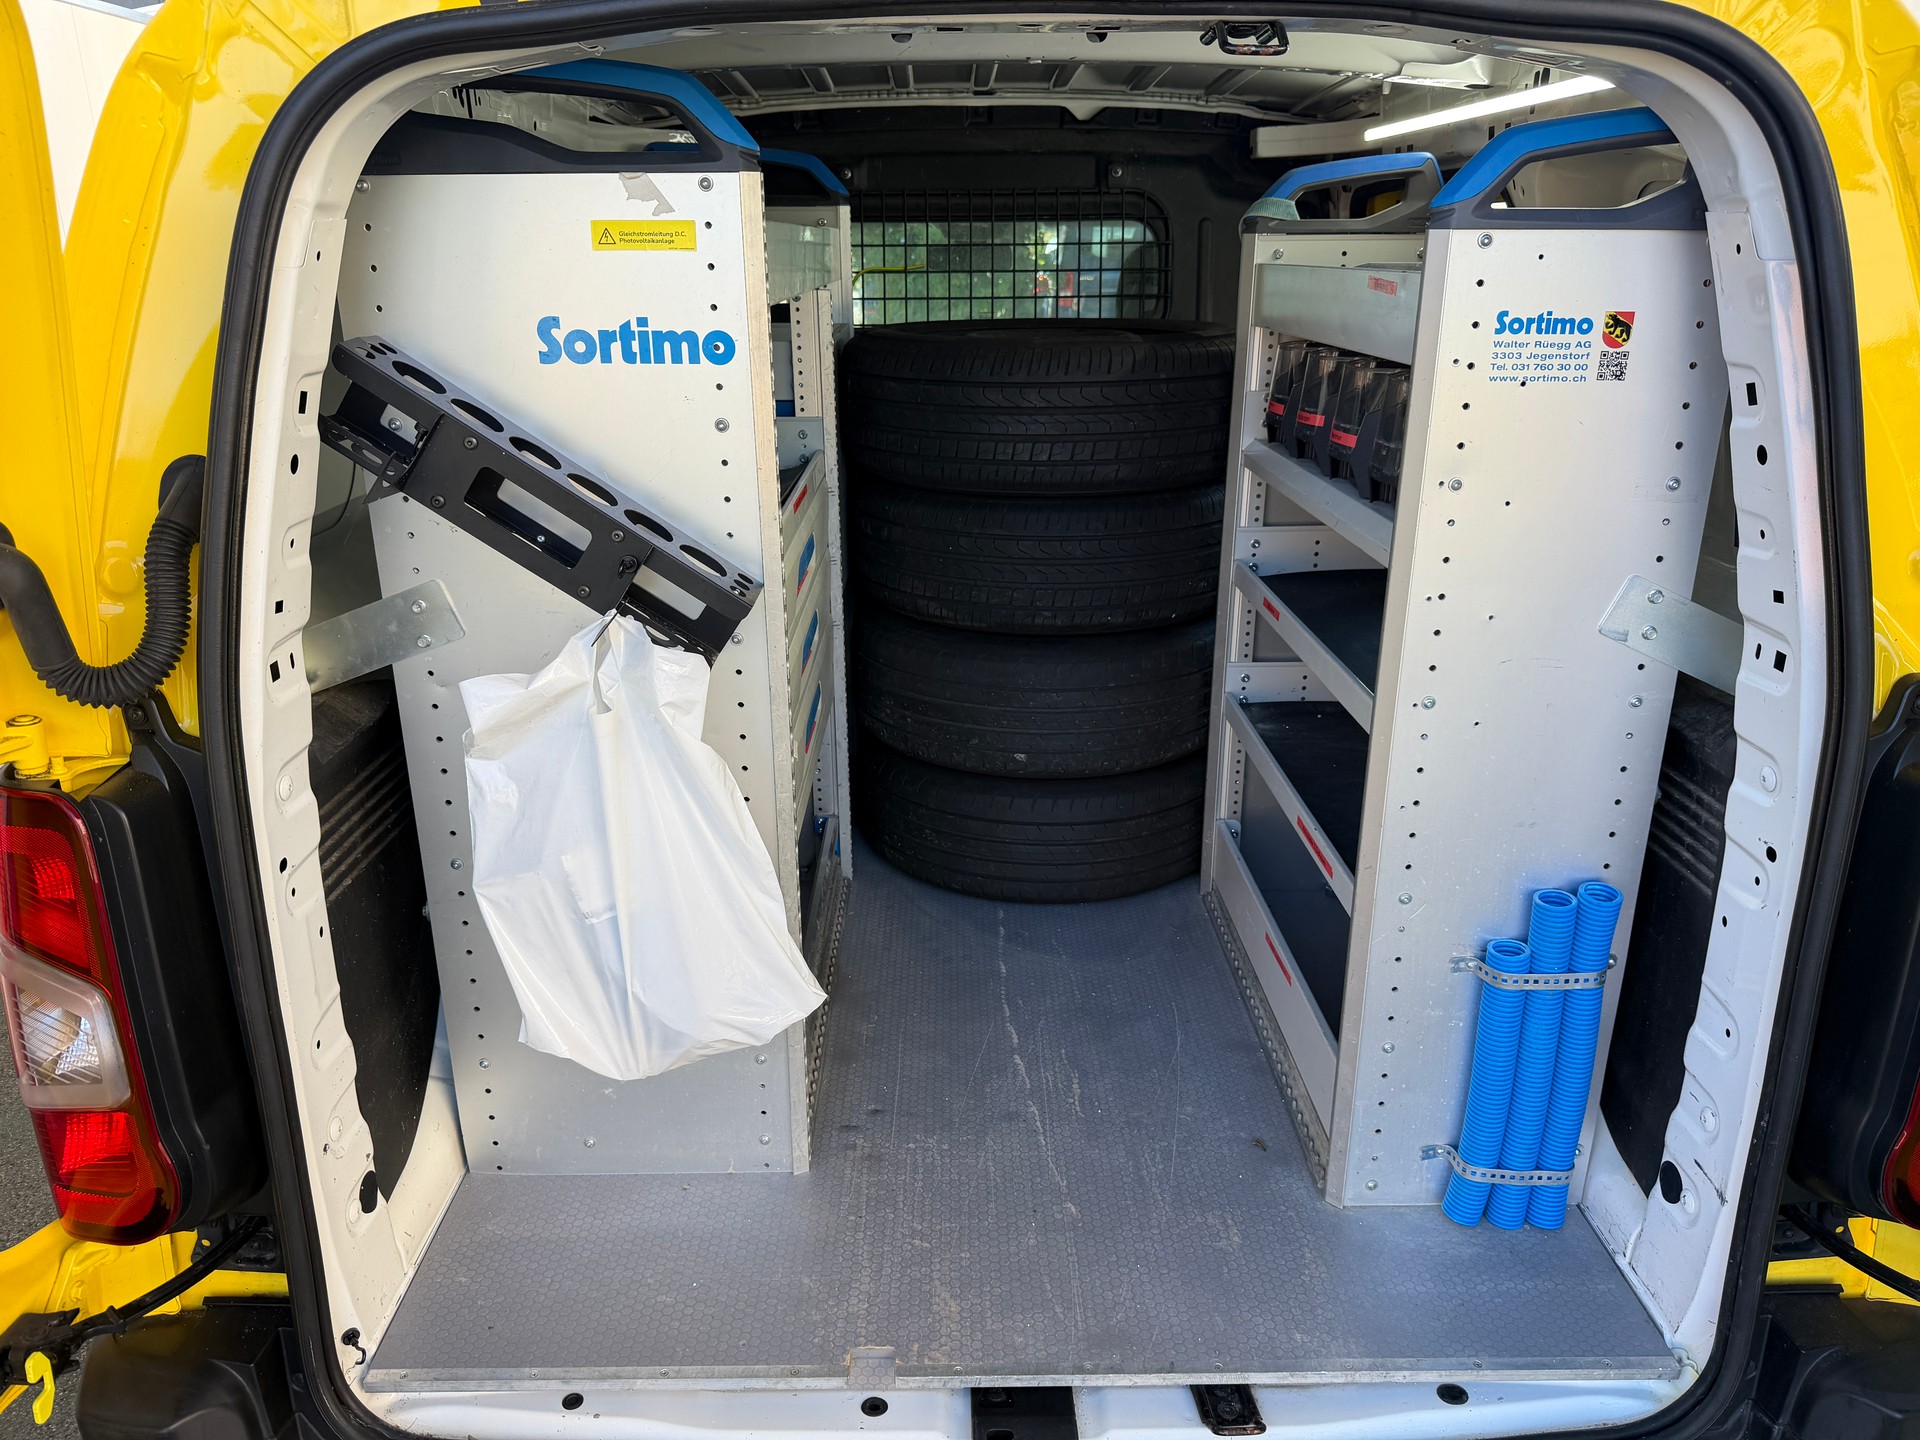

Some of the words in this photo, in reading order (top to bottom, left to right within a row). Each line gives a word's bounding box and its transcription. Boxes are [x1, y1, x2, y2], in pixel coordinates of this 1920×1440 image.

[618, 230, 674, 238] Gleichstromleitung
[1494, 310, 1594, 335] Sortimo
[536, 316, 736, 365] Sortimo
[1493, 340, 1531, 349] Walter
[1534, 340, 1571, 350] Rüegg
[1575, 340, 1592, 349] AG
[1492, 352, 1522, 360] 3303
[1526, 352, 1590, 362] Jegenstorf
[1490, 363, 1508, 371] Tel.
[1511, 363, 1530, 371] 031
[1533, 363, 1554, 371] 760
[1556, 363, 1571, 371] 30
[1573, 363, 1589, 371] 00
[1489, 374, 1587, 383] www.sortimo.ch
